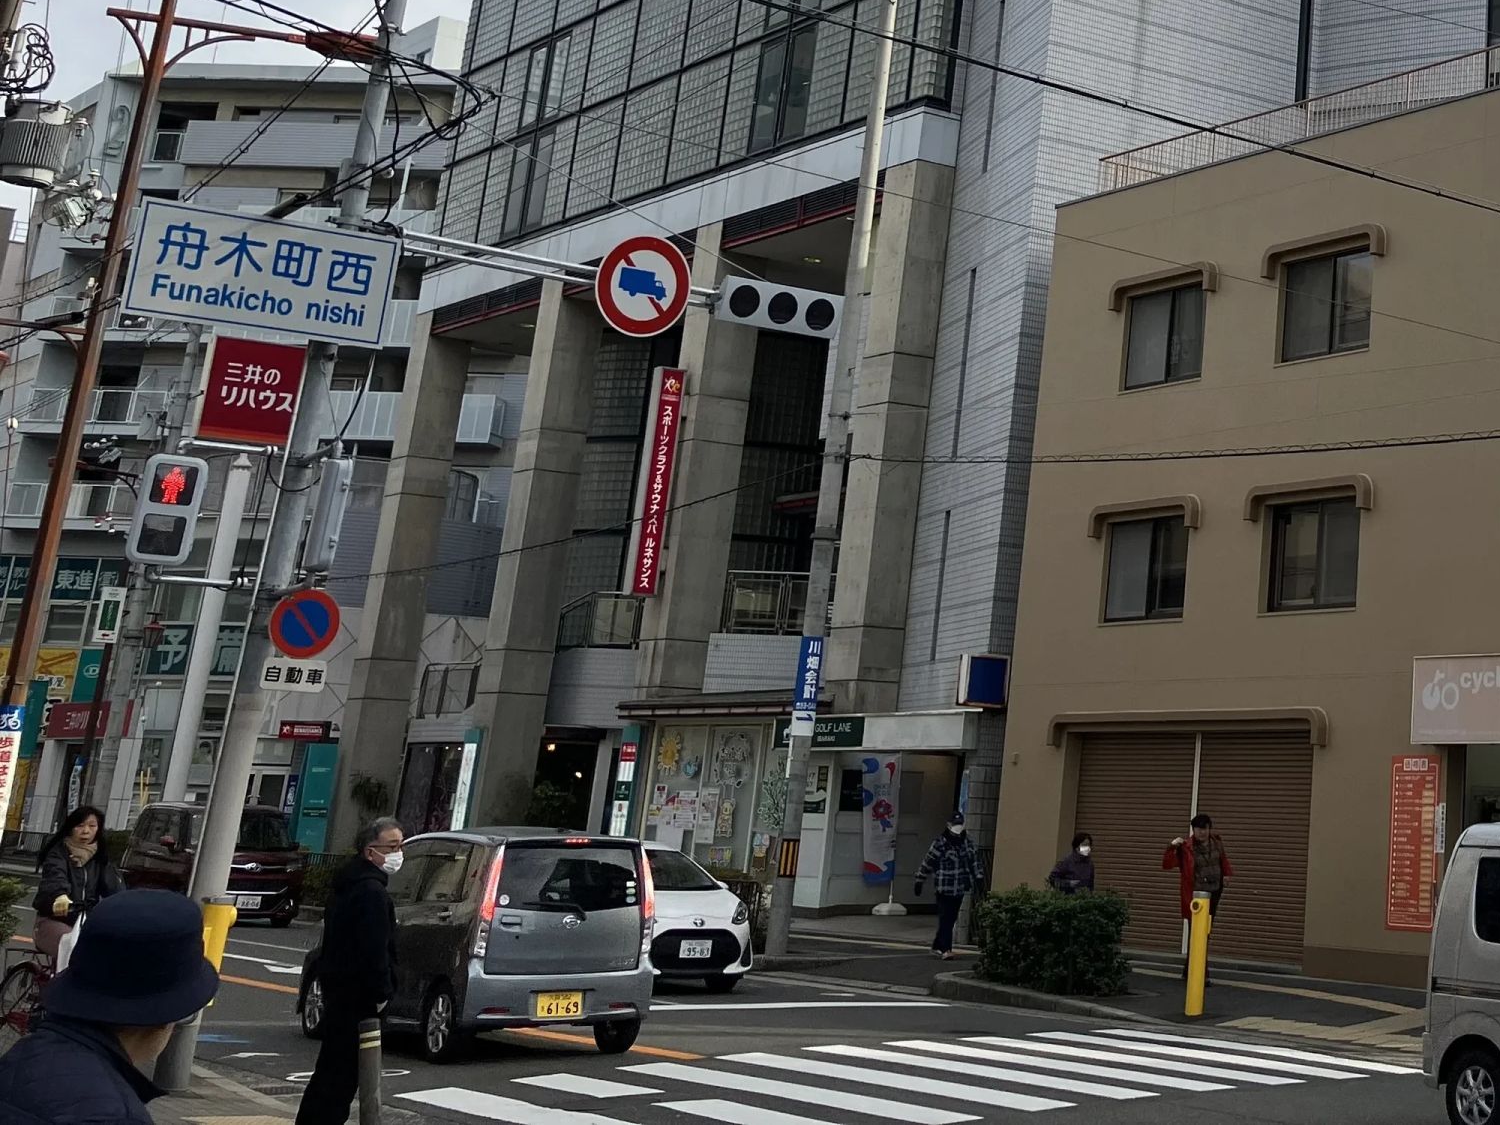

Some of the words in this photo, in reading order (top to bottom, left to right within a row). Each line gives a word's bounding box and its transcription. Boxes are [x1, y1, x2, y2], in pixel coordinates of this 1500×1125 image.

[156, 221, 377, 296] 舟木町西
[150, 273, 293, 316] Funakicho
[305, 299, 366, 327] nishi
[224, 362, 281, 386] 三井の
[220, 385, 293, 413] リハウス
[647, 405, 673, 535] スポーツクラブ&サウナスパ
[639, 537, 656, 589] ルネサンス
[264, 665, 324, 686] 自動車
[803, 640, 822, 699] 川畑会計
[815, 723, 833, 733] GOLF
[833, 722, 852, 733] LANE
[546, 1001, 579, 1015] 61-69
